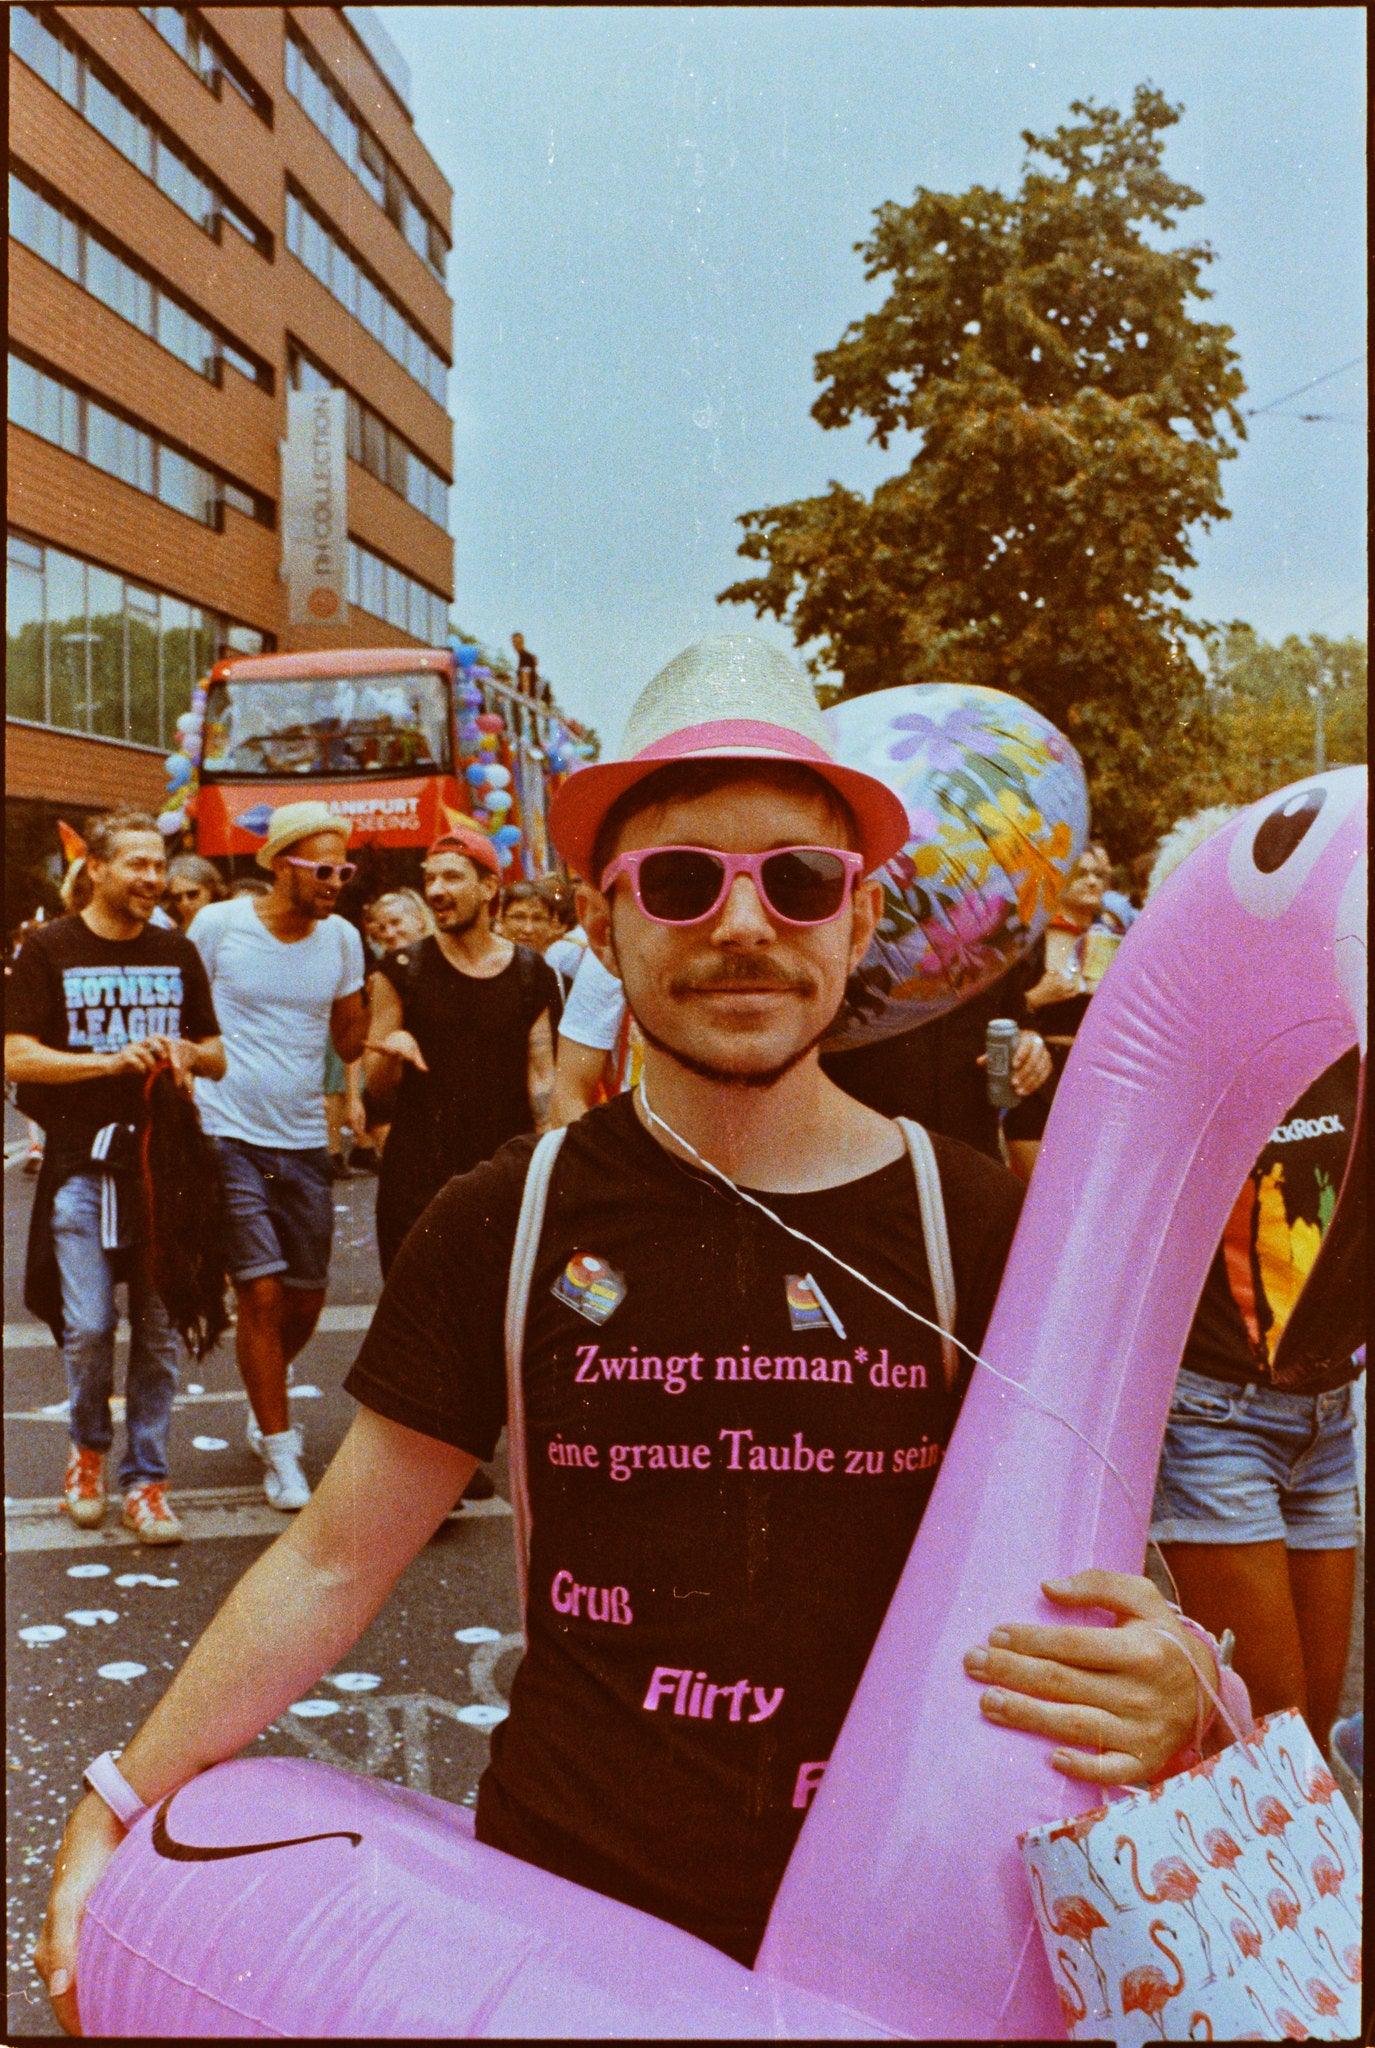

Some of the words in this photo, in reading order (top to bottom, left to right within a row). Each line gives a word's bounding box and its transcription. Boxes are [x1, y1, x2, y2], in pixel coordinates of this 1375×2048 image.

[313, 394, 333, 539] COLLECTION
[63, 976, 184, 1009] HOTNESS
[67, 1007, 181, 1046] LEAGUE
[574, 1344, 704, 1394] Zwingt
[548, 1432, 600, 1468] eine
[609, 1444, 711, 1482] graue
[719, 1428, 835, 1473] Taube
[845, 1449, 884, 1474] zu
[551, 1570, 633, 1625] Gruß
[642, 1666, 785, 1723] Flirty
